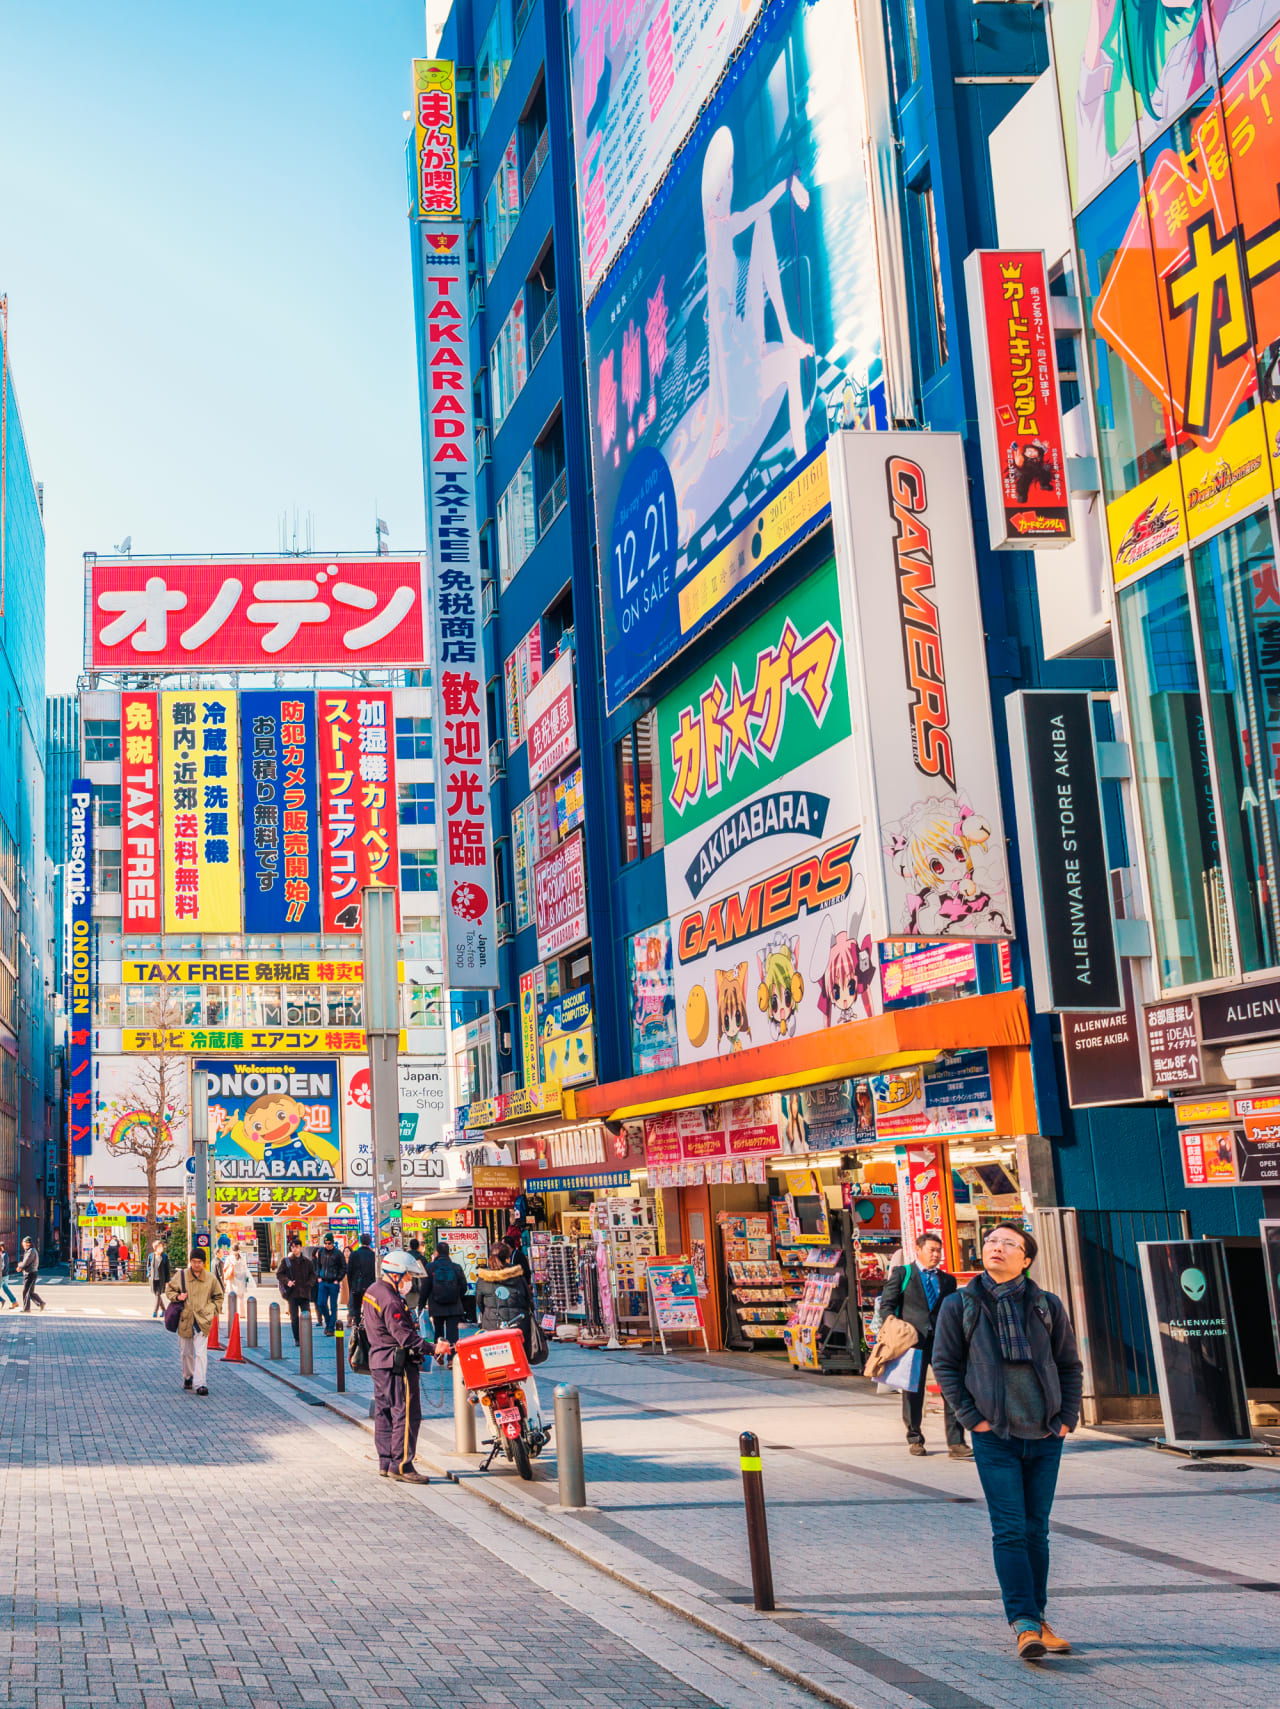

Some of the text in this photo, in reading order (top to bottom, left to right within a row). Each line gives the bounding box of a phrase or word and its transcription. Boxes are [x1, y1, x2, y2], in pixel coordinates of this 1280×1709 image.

[419, 92, 456, 212] まんが喫茶
[426, 276, 468, 463] TAKARADA
[1001, 281, 1040, 436] カードキングダム
[615, 491, 669, 600] 12.21
[98, 564, 416, 653] オノデン
[622, 567, 670, 633] ON SALE
[436, 569, 476, 664] 免税商店
[886, 456, 957, 793] GAMERS
[441, 670, 487, 868] 歓迎光臨
[125, 702, 155, 919] 免税 TAX FREE
[253, 716, 278, 892] お見積り無料です
[72, 792, 90, 906] Panasonic
[699, 794, 810, 885] AKIHABARA
[1050, 714, 1091, 985] ALIENWARE STORE AKIBA
[545, 854, 565, 880] English
[547, 861, 583, 905] COMPUTER
[549, 887, 585, 927] & MOBILE
[680, 835, 858, 963] GAMERS
[551, 922, 575, 949] TAKARADA
[456, 943, 465, 969] Shop
[466, 929, 475, 969] Tax-free
[73, 920, 89, 1014] ONODEN
[134, 964, 310, 981] TAX FREE 免税店
[562, 990, 586, 1010] DISCOUNT
[561, 1003, 590, 1024] COMPUTERS
[1074, 1015, 1128, 1033] ALIENWARE
[1148, 1005, 1194, 1026] お部屋探し
[135, 1032, 366, 1049] テレビ 冷蔵庫 エアコン 特売
[1075, 1032, 1129, 1050] STORE AKIBA
[1167, 1025, 1196, 1041] iDEAL
[1167, 1040, 1197, 1051] アイデアル
[234, 1064, 296, 1074] Welcome to
[404, 1072, 442, 1081] Japan.
[1156, 1069, 1189, 1083] 入口はこちら
[400, 1088, 444, 1098] Tax-free
[506, 1090, 527, 1104] DISCOUNT
[417, 1100, 444, 1110] Shop
[1257, 1142, 1275, 1150] STORE
[1189, 1166, 1203, 1175] TOY
[1260, 1160, 1277, 1168] OPEN
[1261, 1170, 1279, 1178] CLOSE
[220, 1203, 316, 1216] オノデン
[1170, 1318, 1226, 1327] ALIENWARE
[1171, 1328, 1227, 1337] STORE AKIBA
